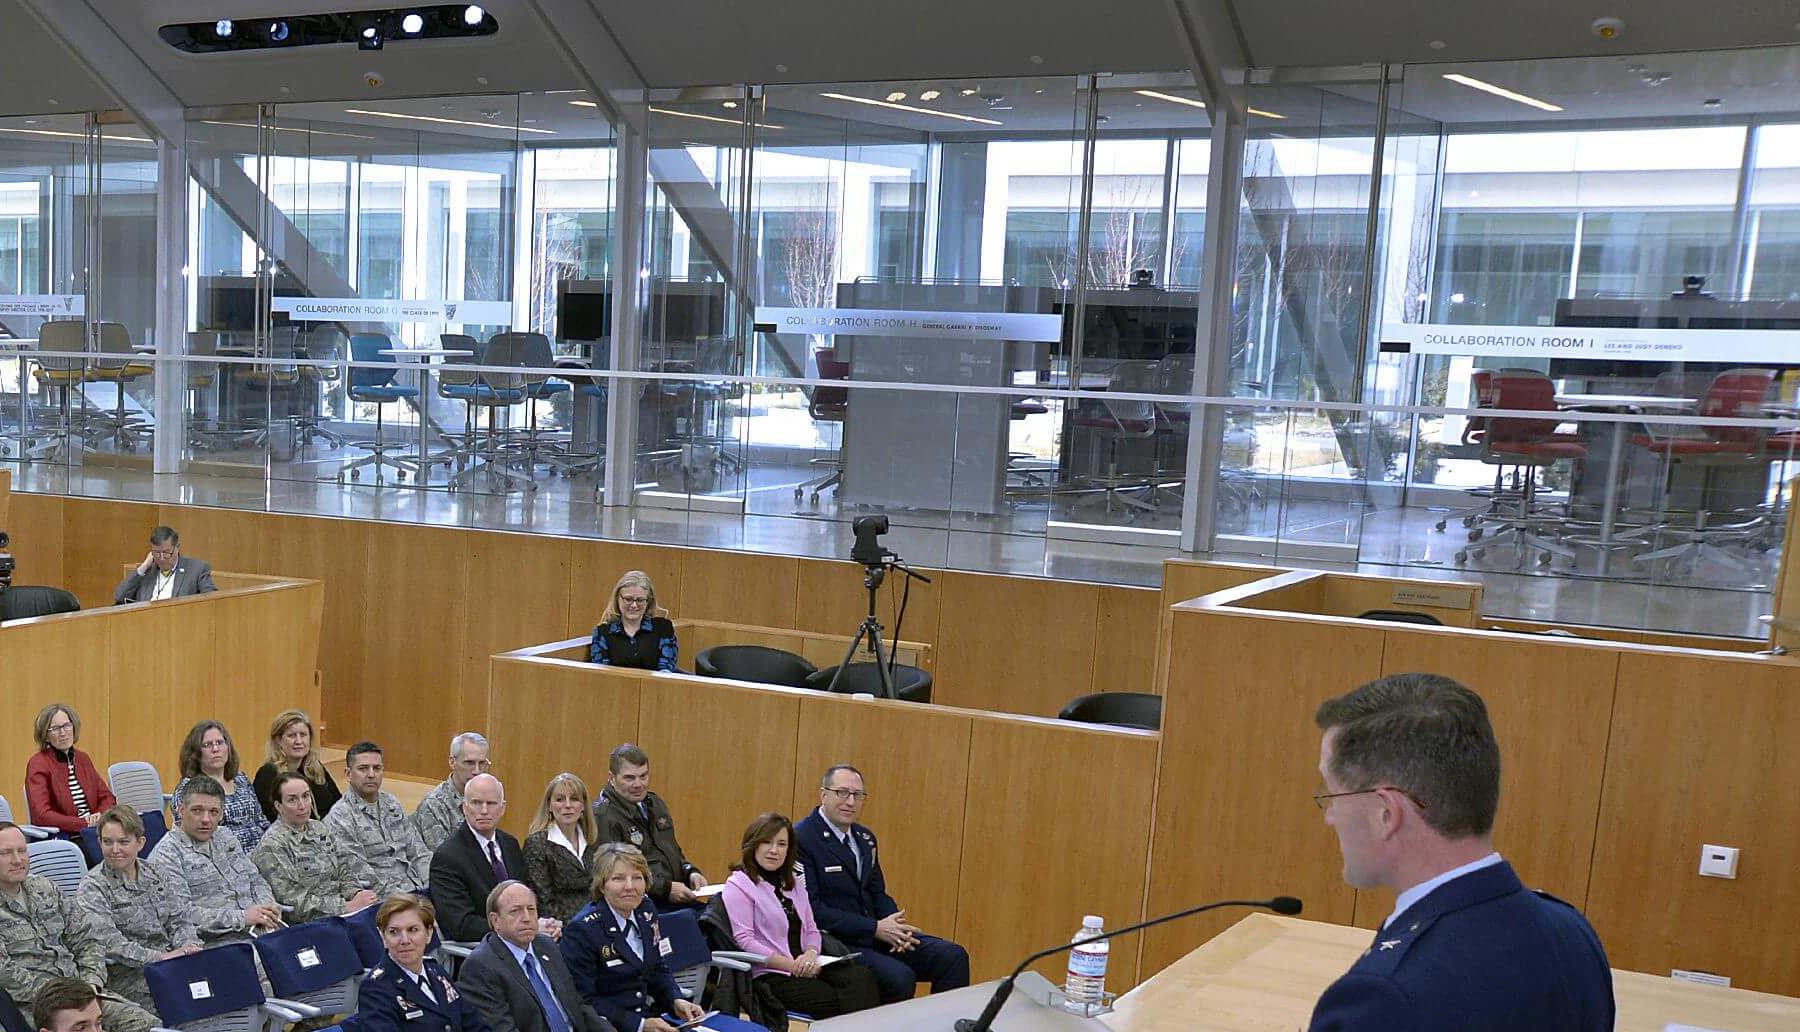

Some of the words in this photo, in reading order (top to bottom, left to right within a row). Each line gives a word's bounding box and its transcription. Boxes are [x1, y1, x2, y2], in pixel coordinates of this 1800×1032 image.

[296, 304, 361, 314] COLLABORATION
[787, 317, 869, 327] COLBRATION
[874, 318, 905, 328] ROOM
[1424, 334, 1536, 347] COLLABORATION
[1541, 337, 1584, 348] ROOM
